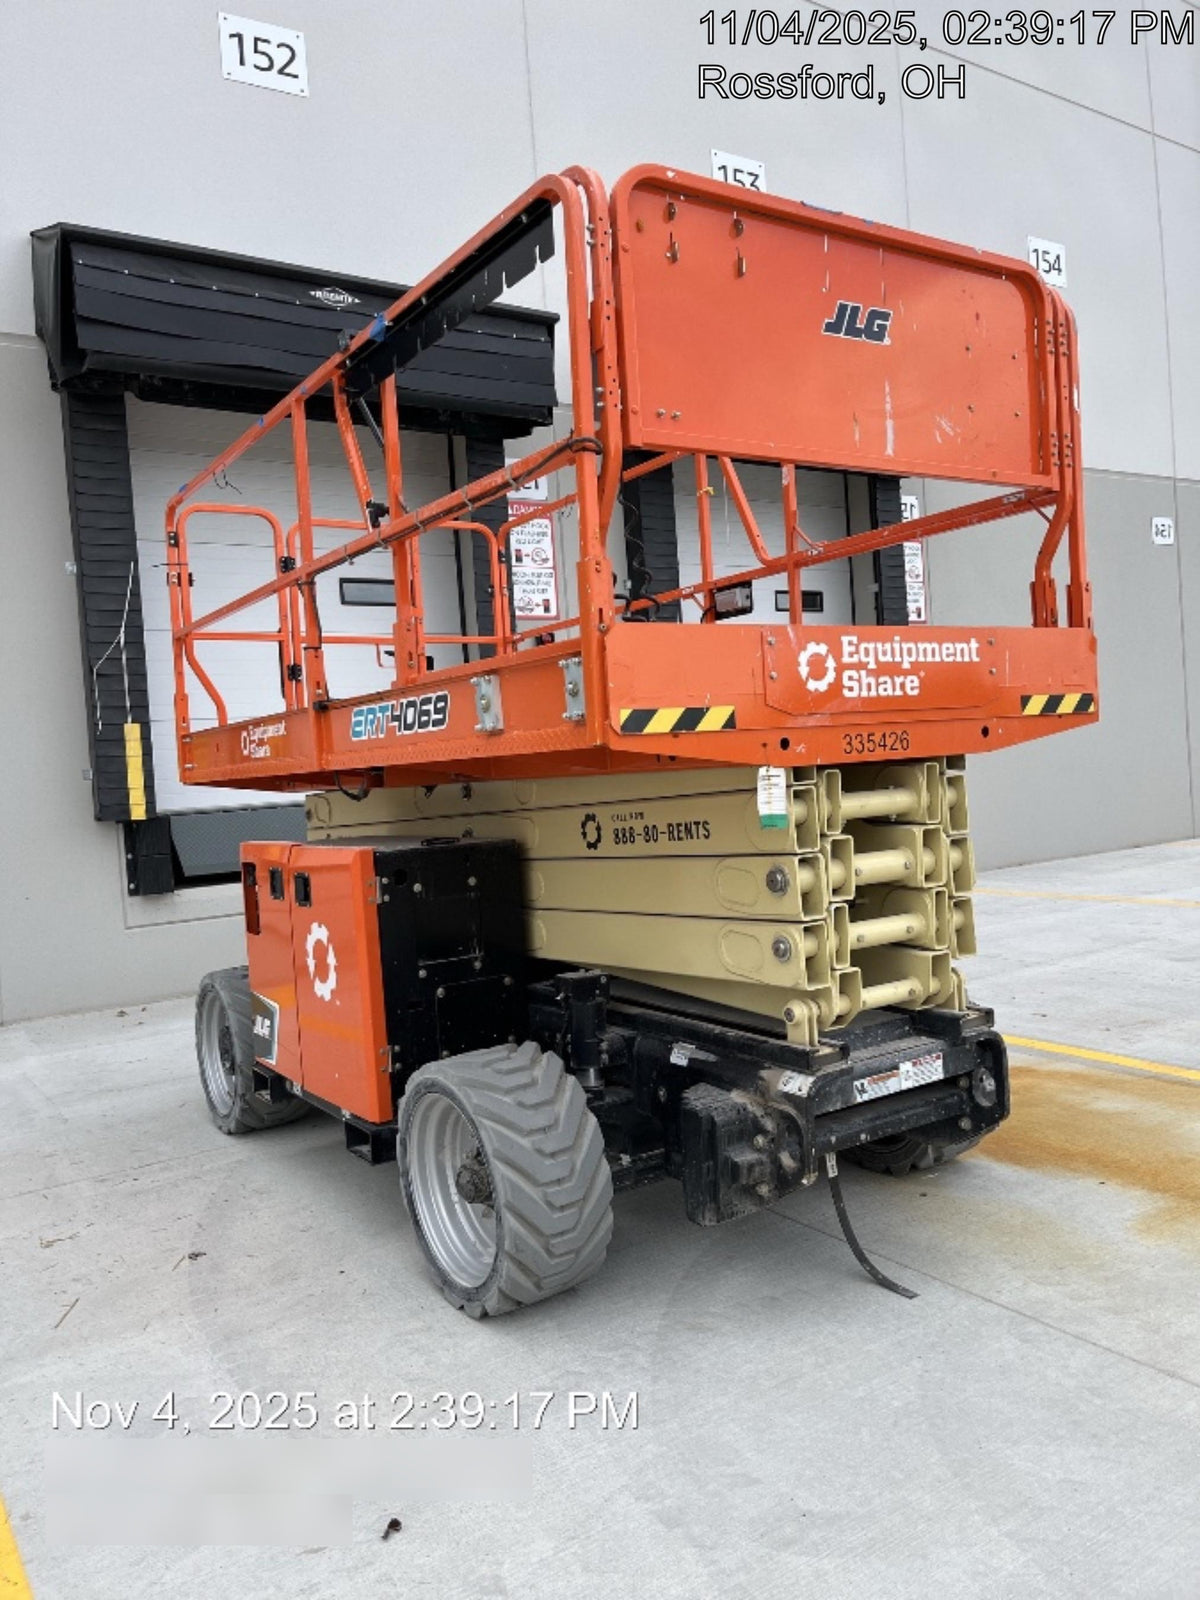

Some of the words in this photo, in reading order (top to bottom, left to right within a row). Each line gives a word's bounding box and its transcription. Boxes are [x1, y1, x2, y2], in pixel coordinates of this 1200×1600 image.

[228, 32, 299, 79] 152
[1032, 248, 1063, 276] 154
[821, 300, 893, 345] JLG
[840, 635, 980, 669] Equipment
[842, 669, 920, 698] Share
[351, 691, 450, 741] ERT4069
[842, 730, 910, 755] 335426
[612, 820, 711, 846] 888-80-RENTS
